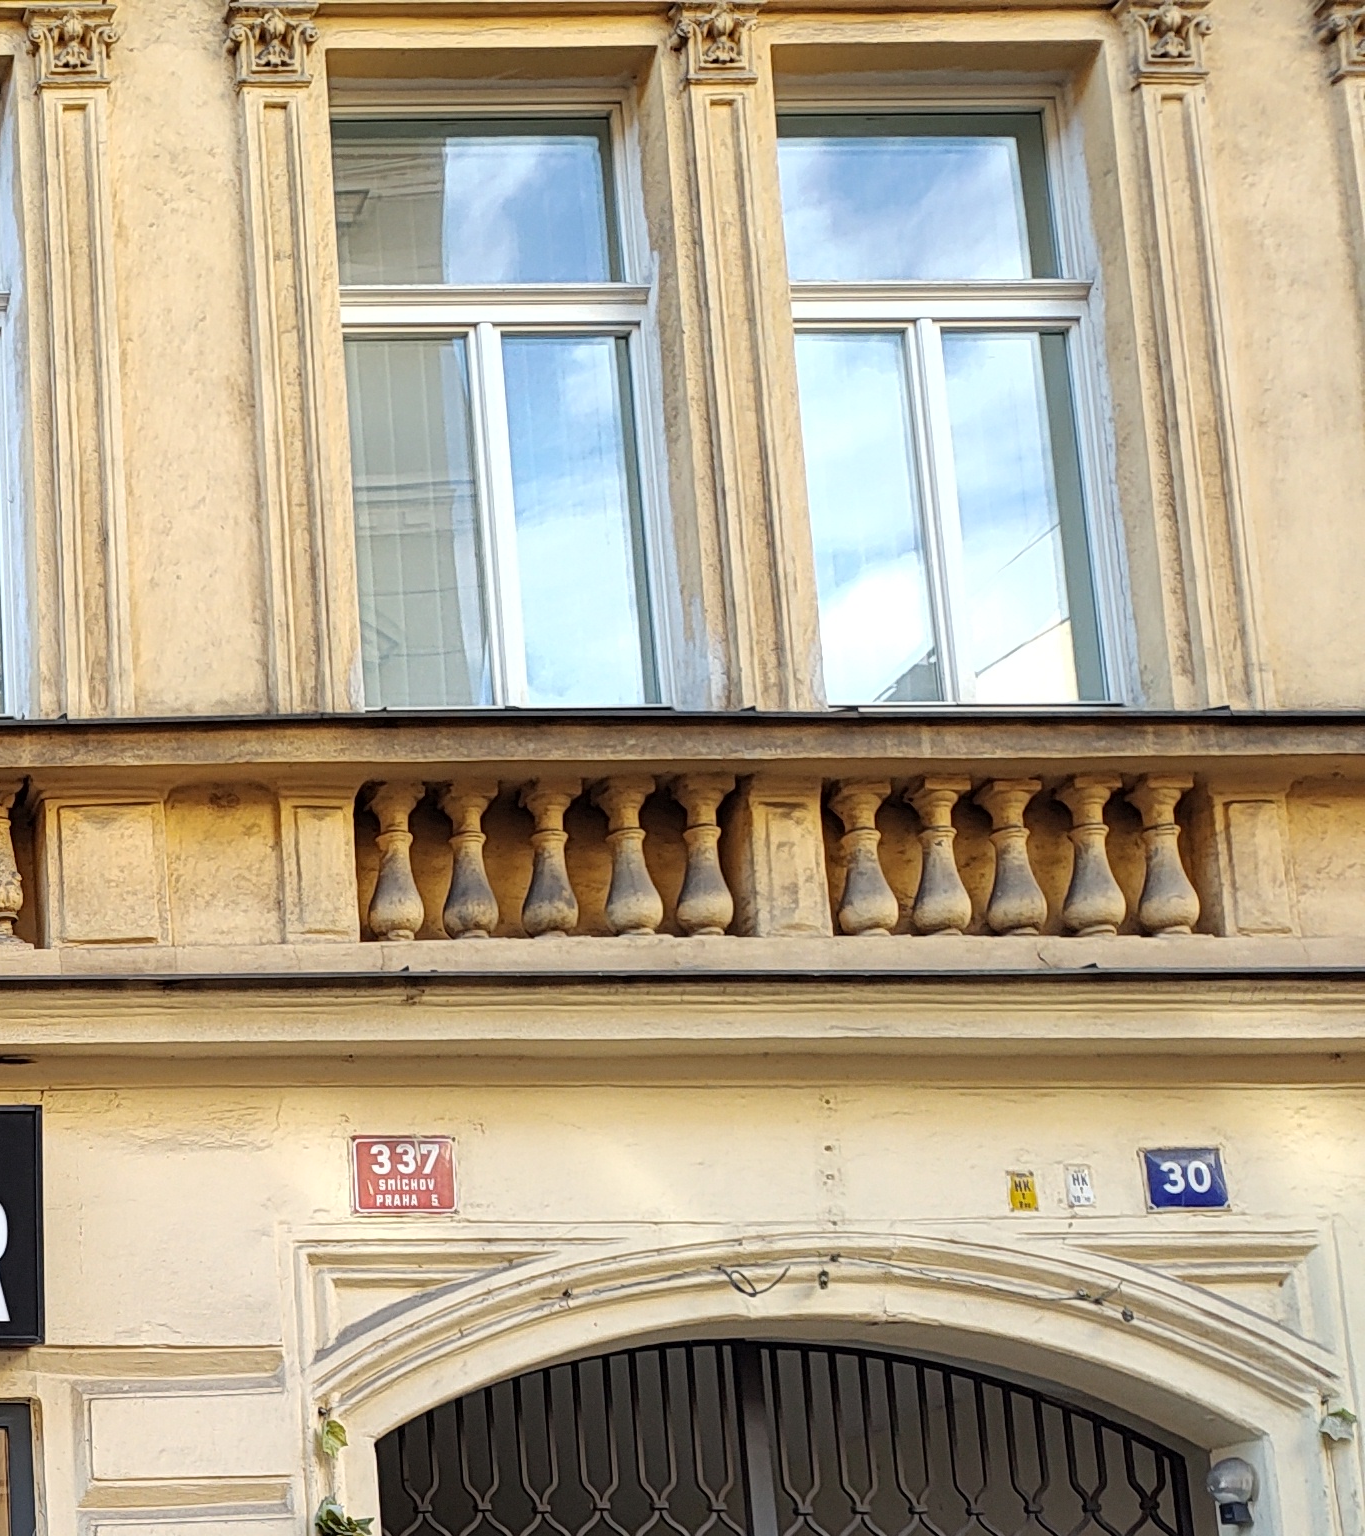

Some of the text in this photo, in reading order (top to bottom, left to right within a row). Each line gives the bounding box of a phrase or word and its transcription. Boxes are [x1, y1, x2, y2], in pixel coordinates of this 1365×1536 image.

[370, 1143, 440, 1175] 337
[378, 1175, 435, 1190] SMÍCHOV
[1159, 1160, 1212, 1194] 30
[376, 1194, 418, 1206] PRAHA
